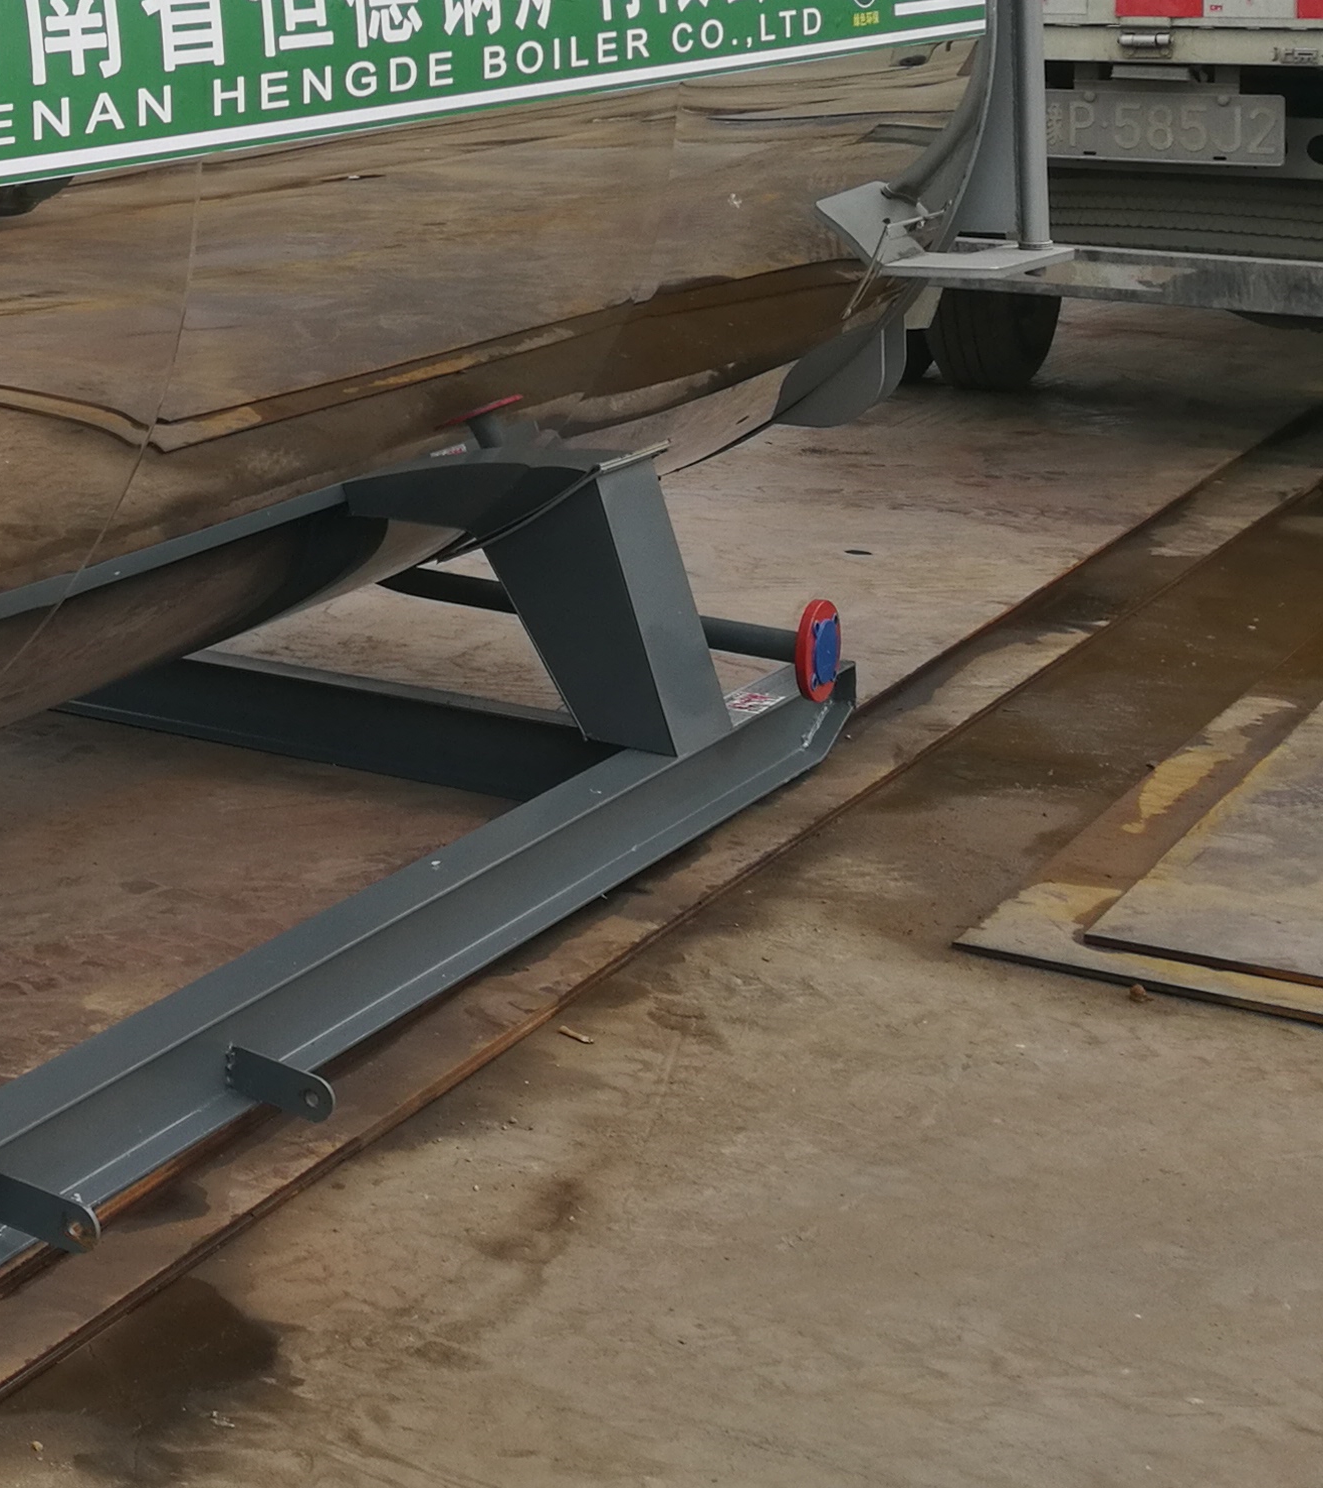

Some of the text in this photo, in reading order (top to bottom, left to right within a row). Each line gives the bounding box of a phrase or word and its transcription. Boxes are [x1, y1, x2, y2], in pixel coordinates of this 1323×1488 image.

[213, 50, 454, 117] HENGDE
[483, 27, 651, 80] BOILER
[672, 7, 823, 53] CO.,LTD
